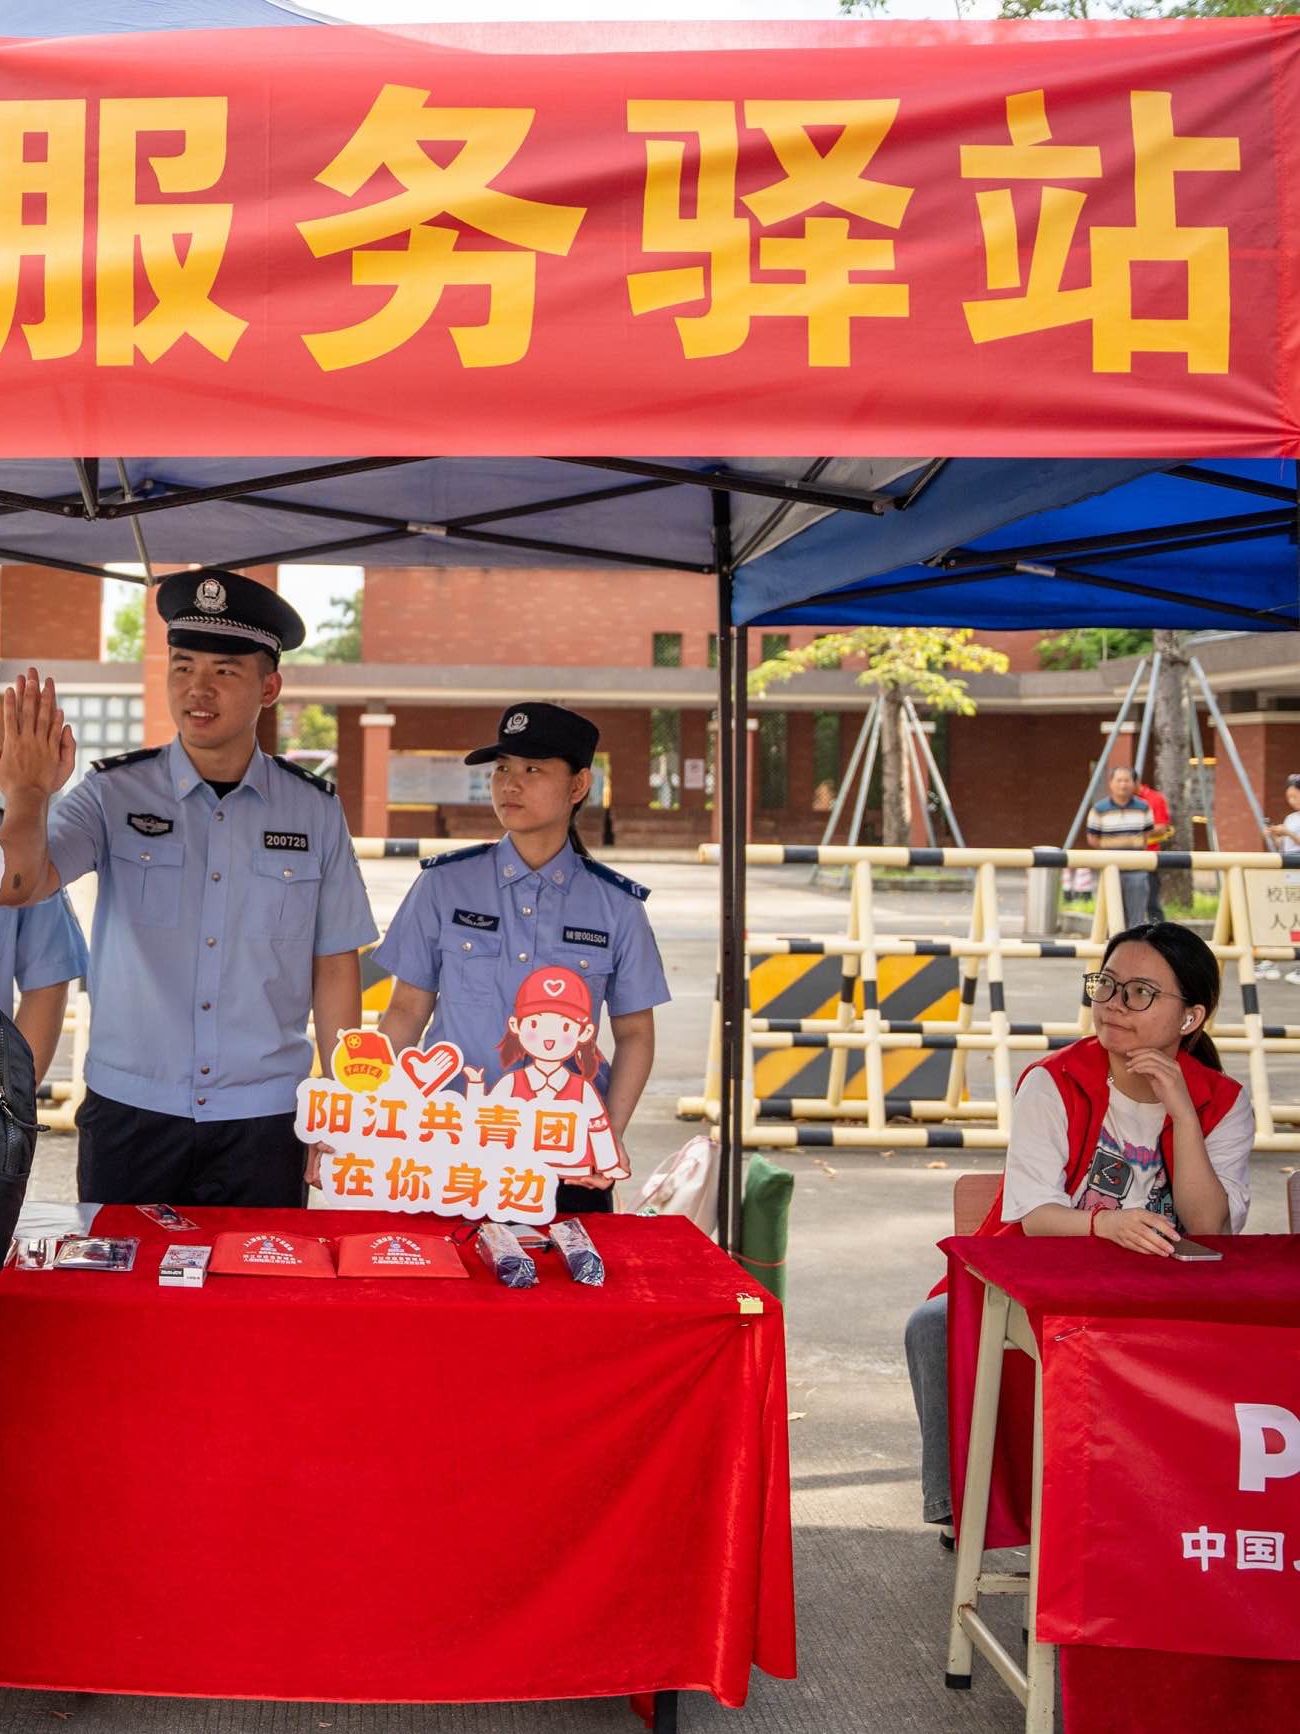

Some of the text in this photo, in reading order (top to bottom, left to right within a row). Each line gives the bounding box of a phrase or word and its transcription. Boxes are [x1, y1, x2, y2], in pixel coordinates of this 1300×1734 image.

[306, 1088, 578, 1154] 阳江共青团
[331, 1152, 547, 1214] 在你身边
[1234, 1402, 1300, 1493] P
[1181, 1525, 1300, 1572] 中国
